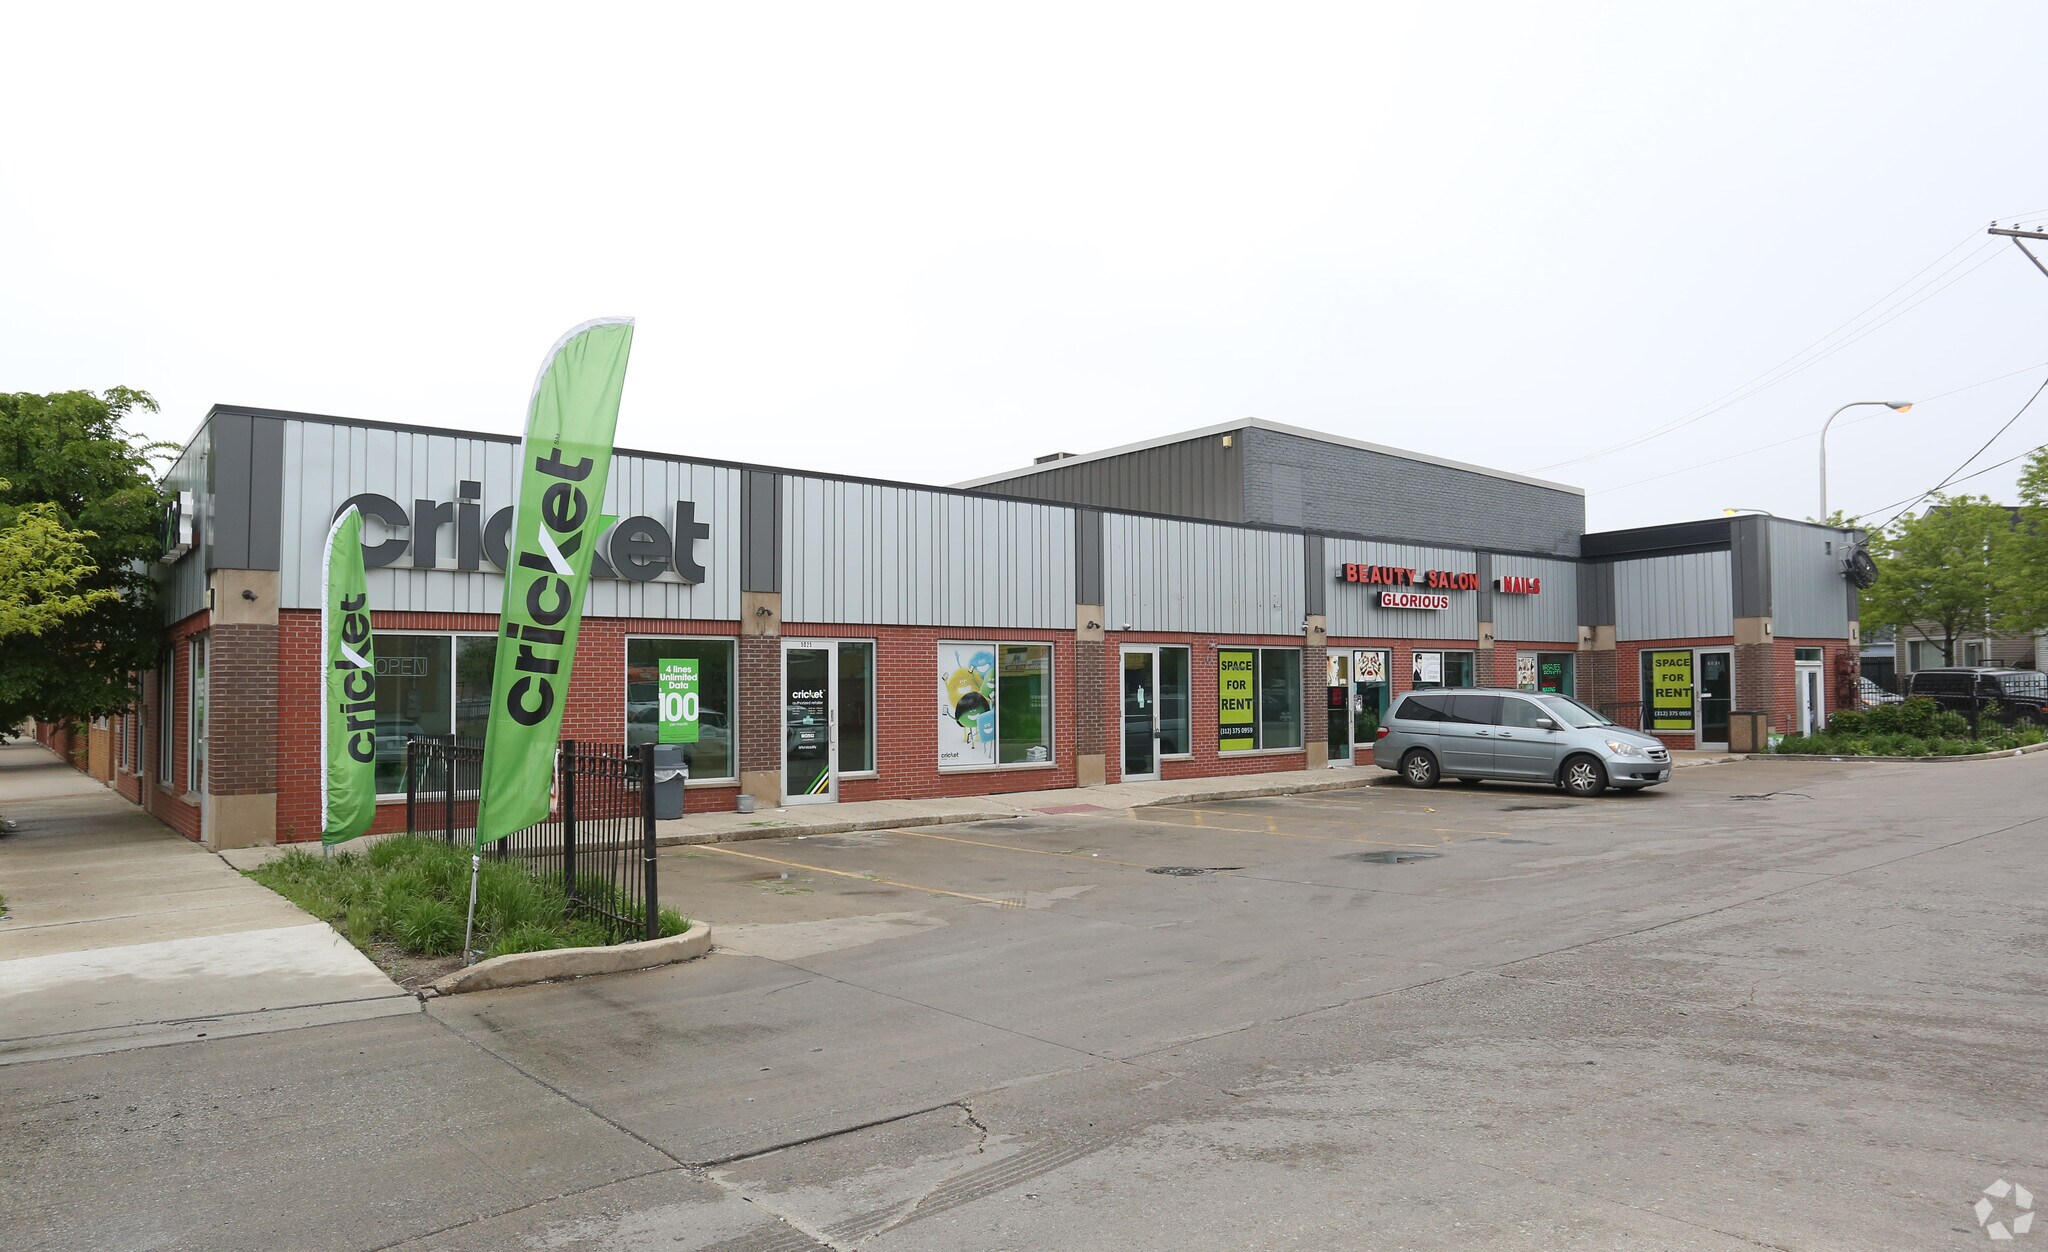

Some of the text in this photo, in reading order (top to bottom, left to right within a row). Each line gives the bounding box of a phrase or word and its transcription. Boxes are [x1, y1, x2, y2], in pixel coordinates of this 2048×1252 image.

[333, 480, 710, 585] criet
[1344, 563, 1479, 590] BEAUTY SALON
[506, 447, 594, 726] cricket
[1503, 576, 1541, 595] NAILS
[1382, 593, 1449, 609] GLORIOUS
[375, 658, 426, 675] OPEN
[1221, 661, 1252, 671] SPACE
[1655, 658, 1690, 667] SPACE
[665, 665, 692, 673] 4 lines
[334, 593, 375, 763] cricket
[660, 673, 698, 681] Unlimited
[1662, 674, 1684, 682] FOR
[1226, 680, 1246, 690] FOR
[792, 689, 823, 699] cricket
[1655, 688, 1691, 697] RENT
[1221, 698, 1252, 710] RENT
[1220, 727, 1232, 735] (312)
